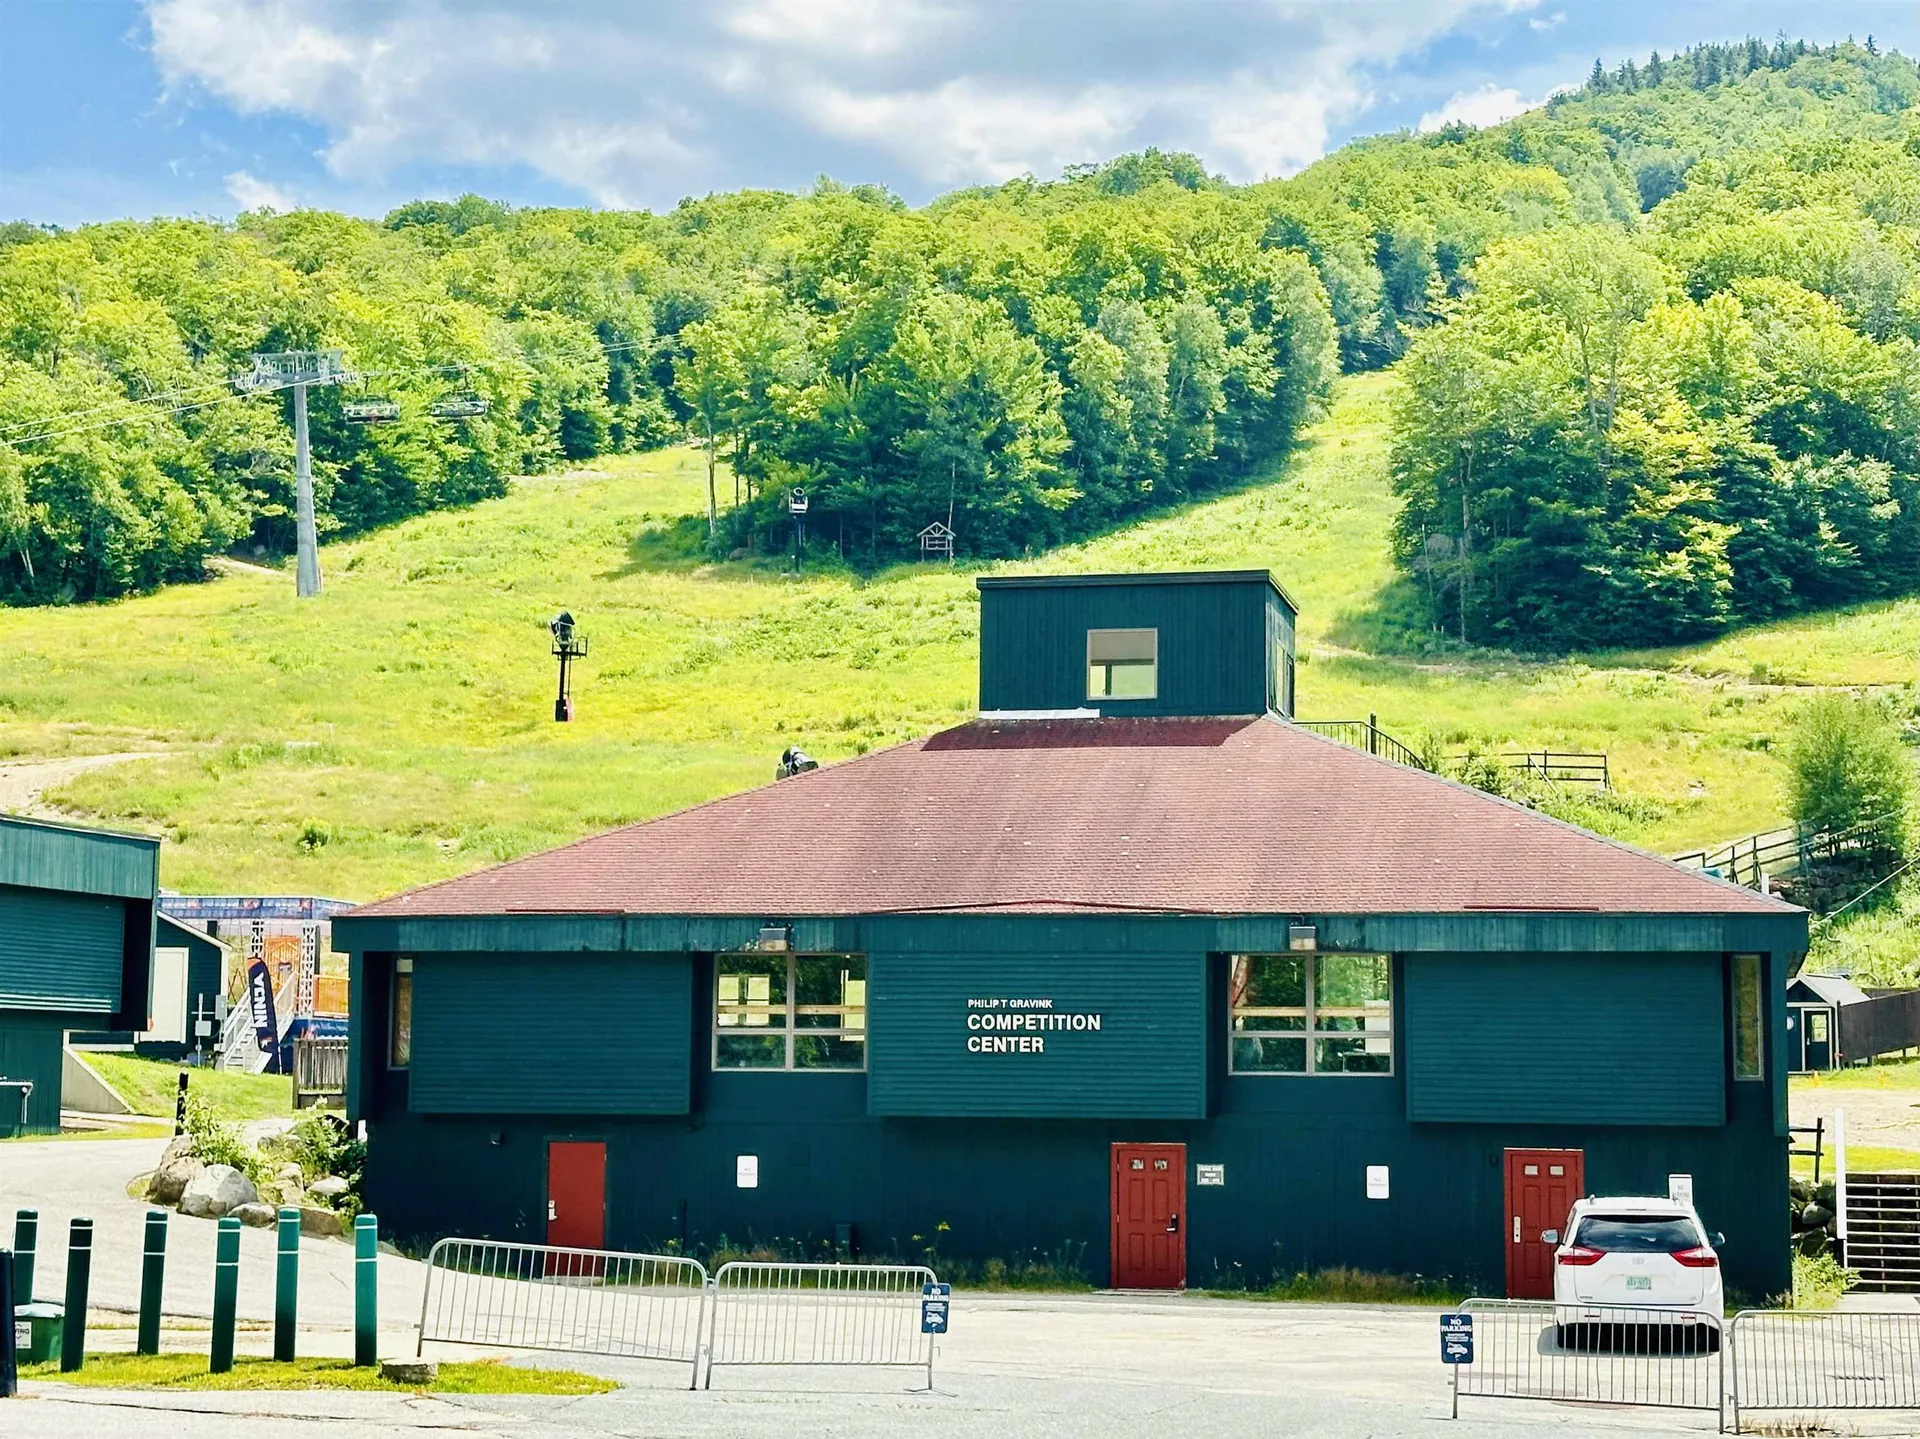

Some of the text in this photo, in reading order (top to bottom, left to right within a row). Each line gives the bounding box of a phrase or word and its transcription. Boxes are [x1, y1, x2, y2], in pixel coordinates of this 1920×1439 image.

[252, 972, 268, 1028] NINJA
[968, 999, 1053, 1008] PHILIP T GRAVINK
[967, 1014, 1101, 1031] COMPETITION
[967, 1036, 1044, 1053] CENTER
